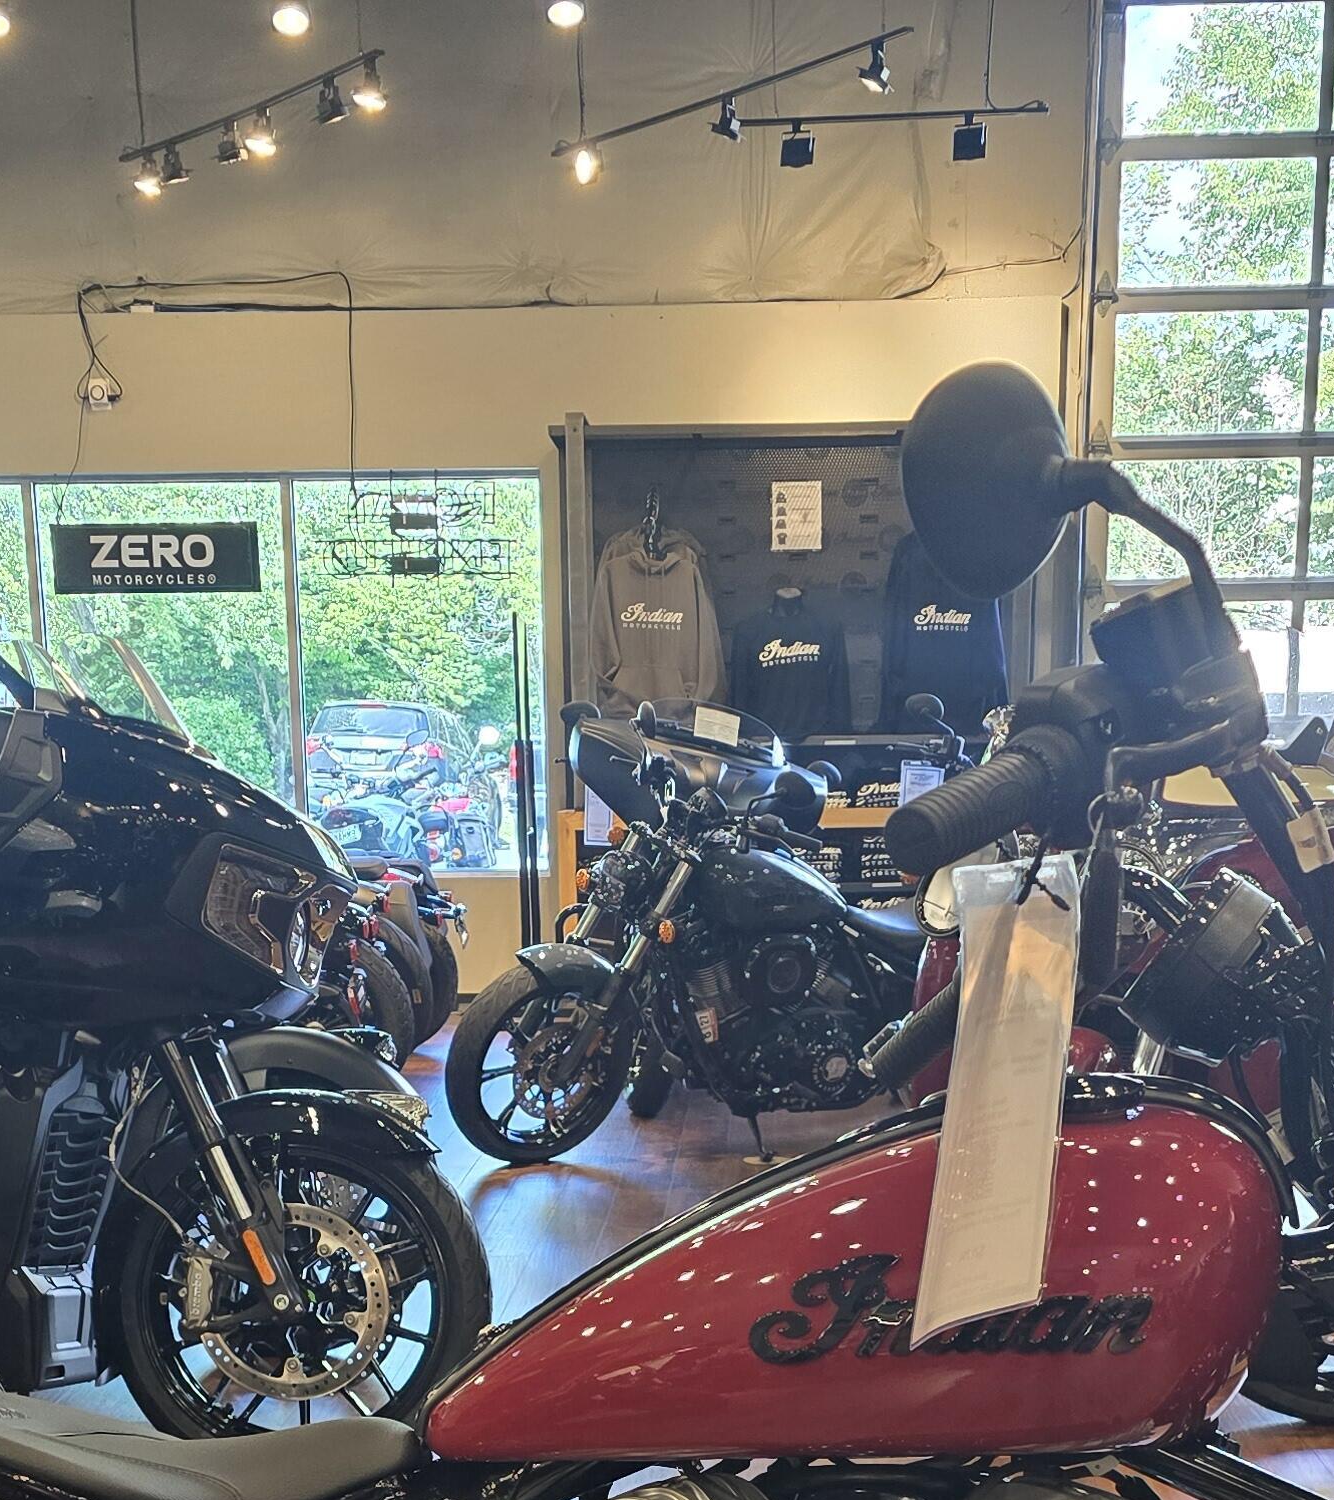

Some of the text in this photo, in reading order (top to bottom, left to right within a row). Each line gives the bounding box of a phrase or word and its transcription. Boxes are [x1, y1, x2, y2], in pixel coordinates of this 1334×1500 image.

[90, 534, 215, 568] ZERO
[621, 603, 683, 624] Indian
[914, 604, 971, 625] Indian
[759, 638, 821, 662] Indian
[762, 656, 818, 668] MOTORCYCLE
